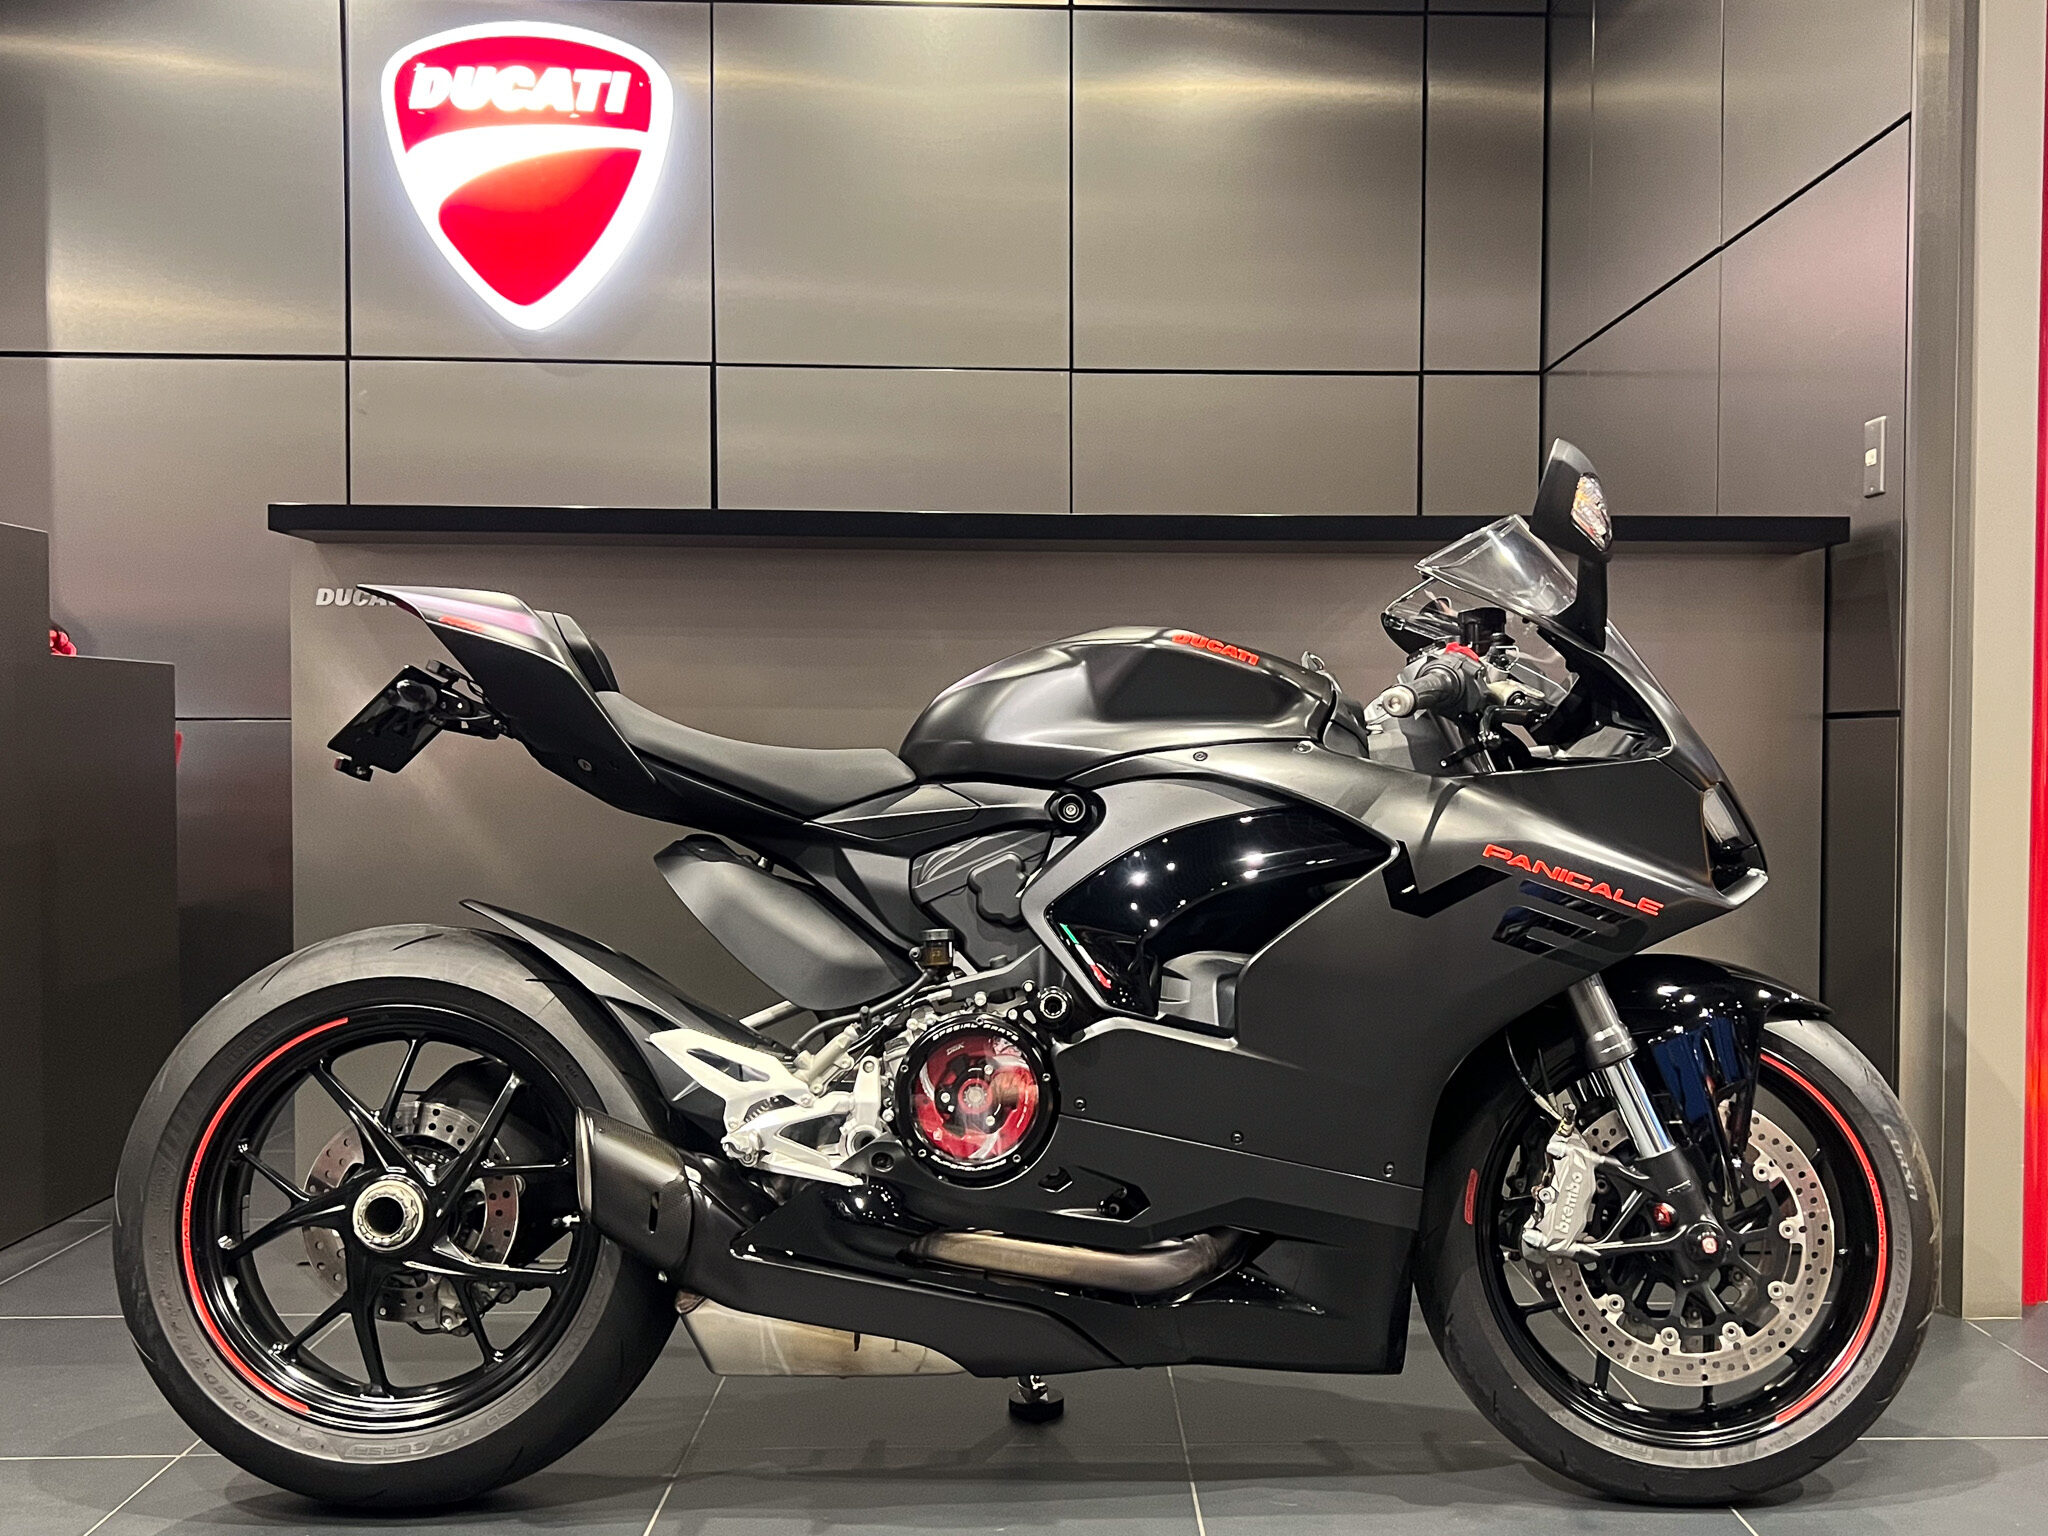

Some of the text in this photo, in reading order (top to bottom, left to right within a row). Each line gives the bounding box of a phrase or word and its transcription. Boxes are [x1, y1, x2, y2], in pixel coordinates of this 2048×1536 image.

[408, 65, 632, 114] DUCATI
[315, 588, 397, 607] DUCA
[1171, 633, 1260, 667] DUCATI
[1482, 843, 1665, 917] PANIGALE
[1882, 1124, 1919, 1201] CORSA
[1554, 1171, 1583, 1234] brembo
